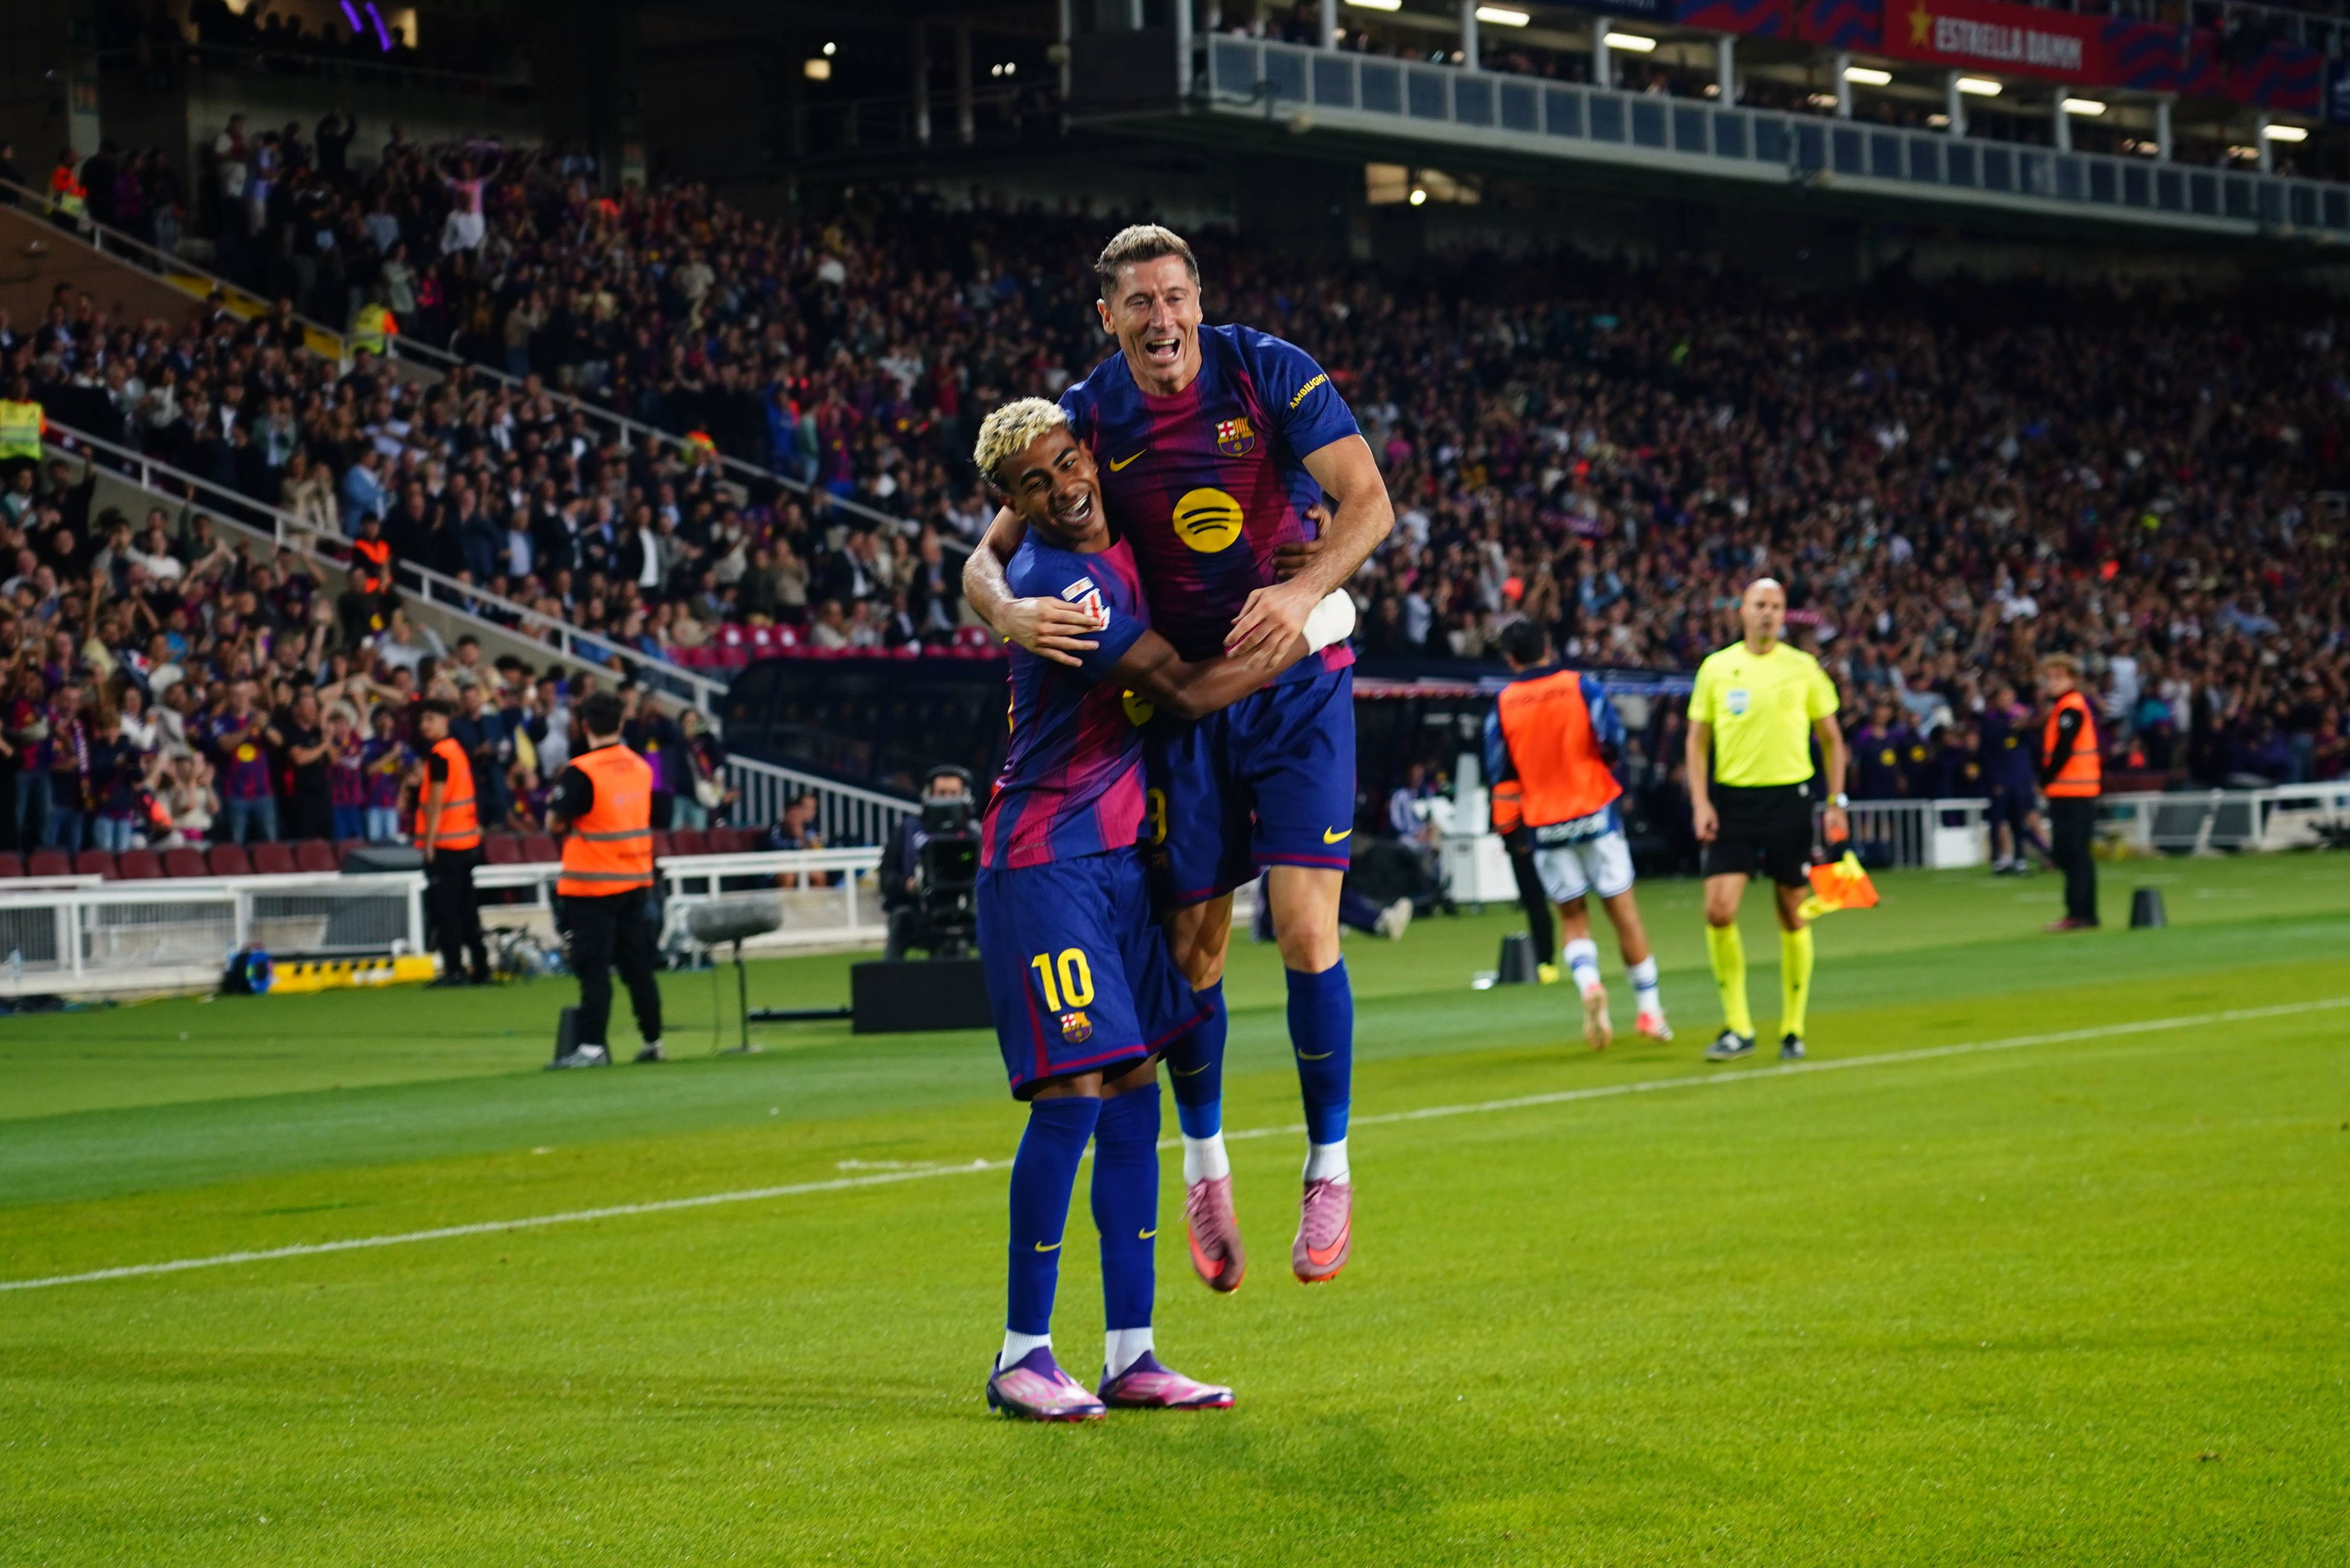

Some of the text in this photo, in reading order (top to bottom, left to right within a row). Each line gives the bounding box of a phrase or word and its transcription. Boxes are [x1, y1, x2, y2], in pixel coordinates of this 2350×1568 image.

[1935, 16, 2083, 70] ESTRELLA DAMM
[1290, 374, 1326, 409] AMBILIGHT
[1031, 948, 1095, 1012] 10
